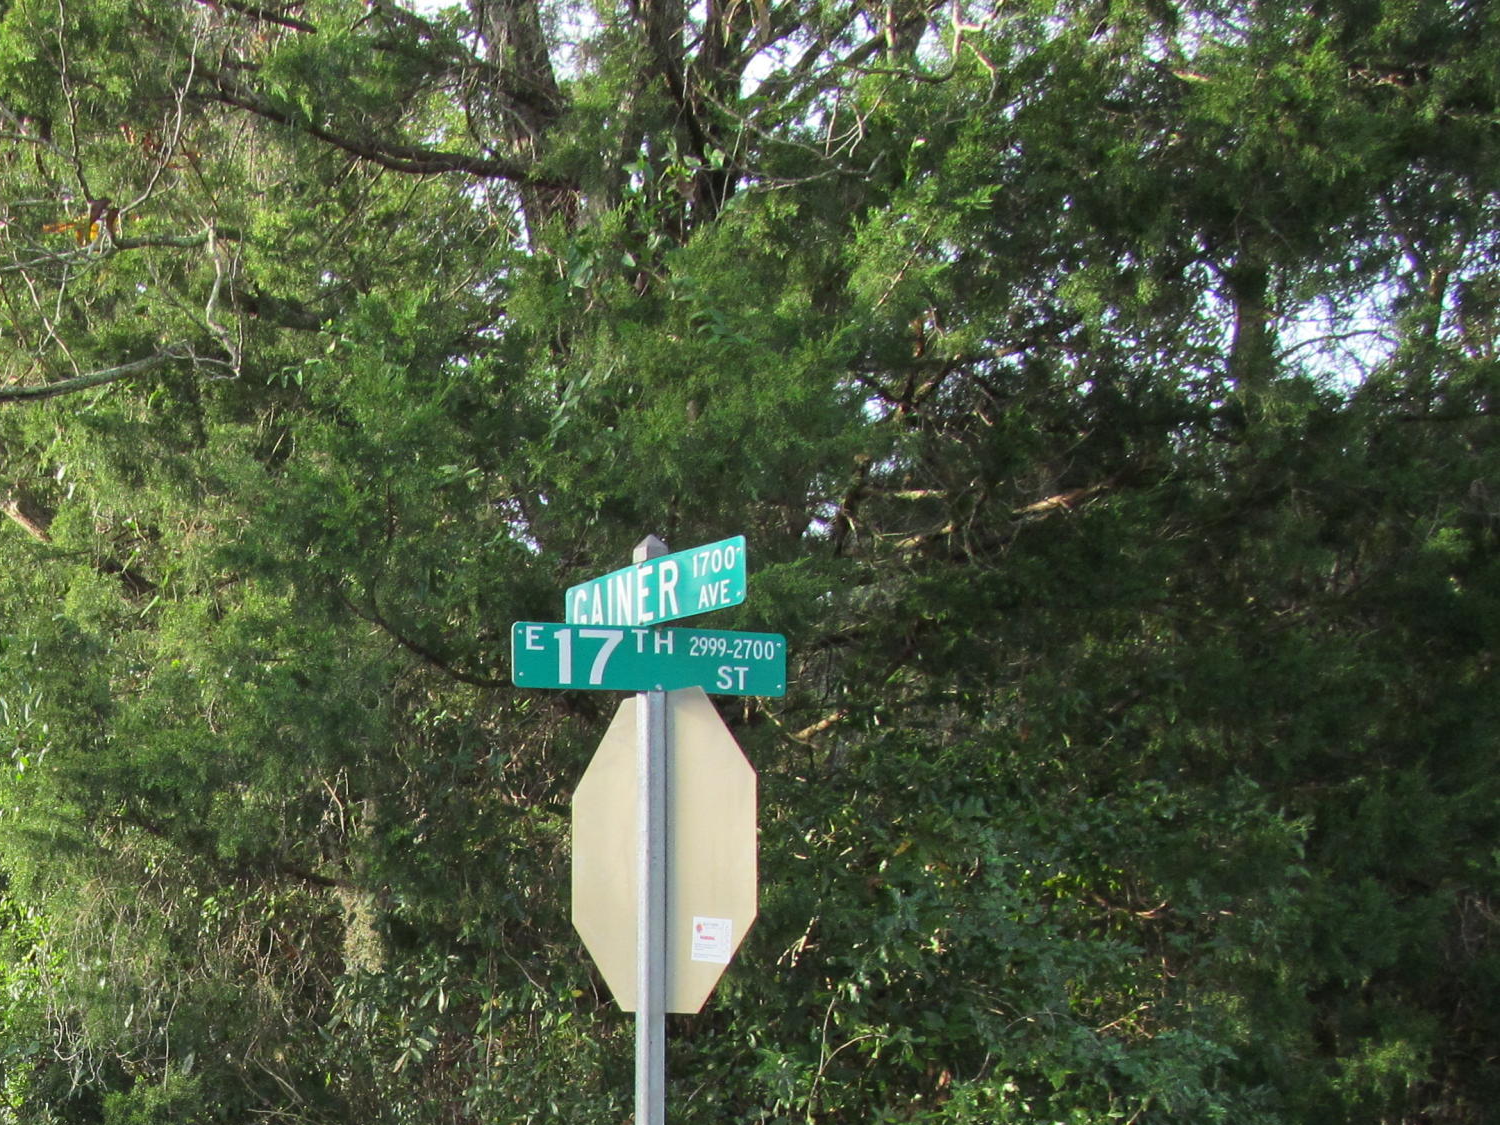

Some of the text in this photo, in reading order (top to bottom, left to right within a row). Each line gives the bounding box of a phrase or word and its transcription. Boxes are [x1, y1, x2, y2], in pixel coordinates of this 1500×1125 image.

[573, 545, 736, 626] GAINER 1700
[698, 579, 731, 609] AVE
[526, 626, 545, 650] E
[689, 636, 775, 660] 2999-2700
[716, 665, 749, 691] ST
